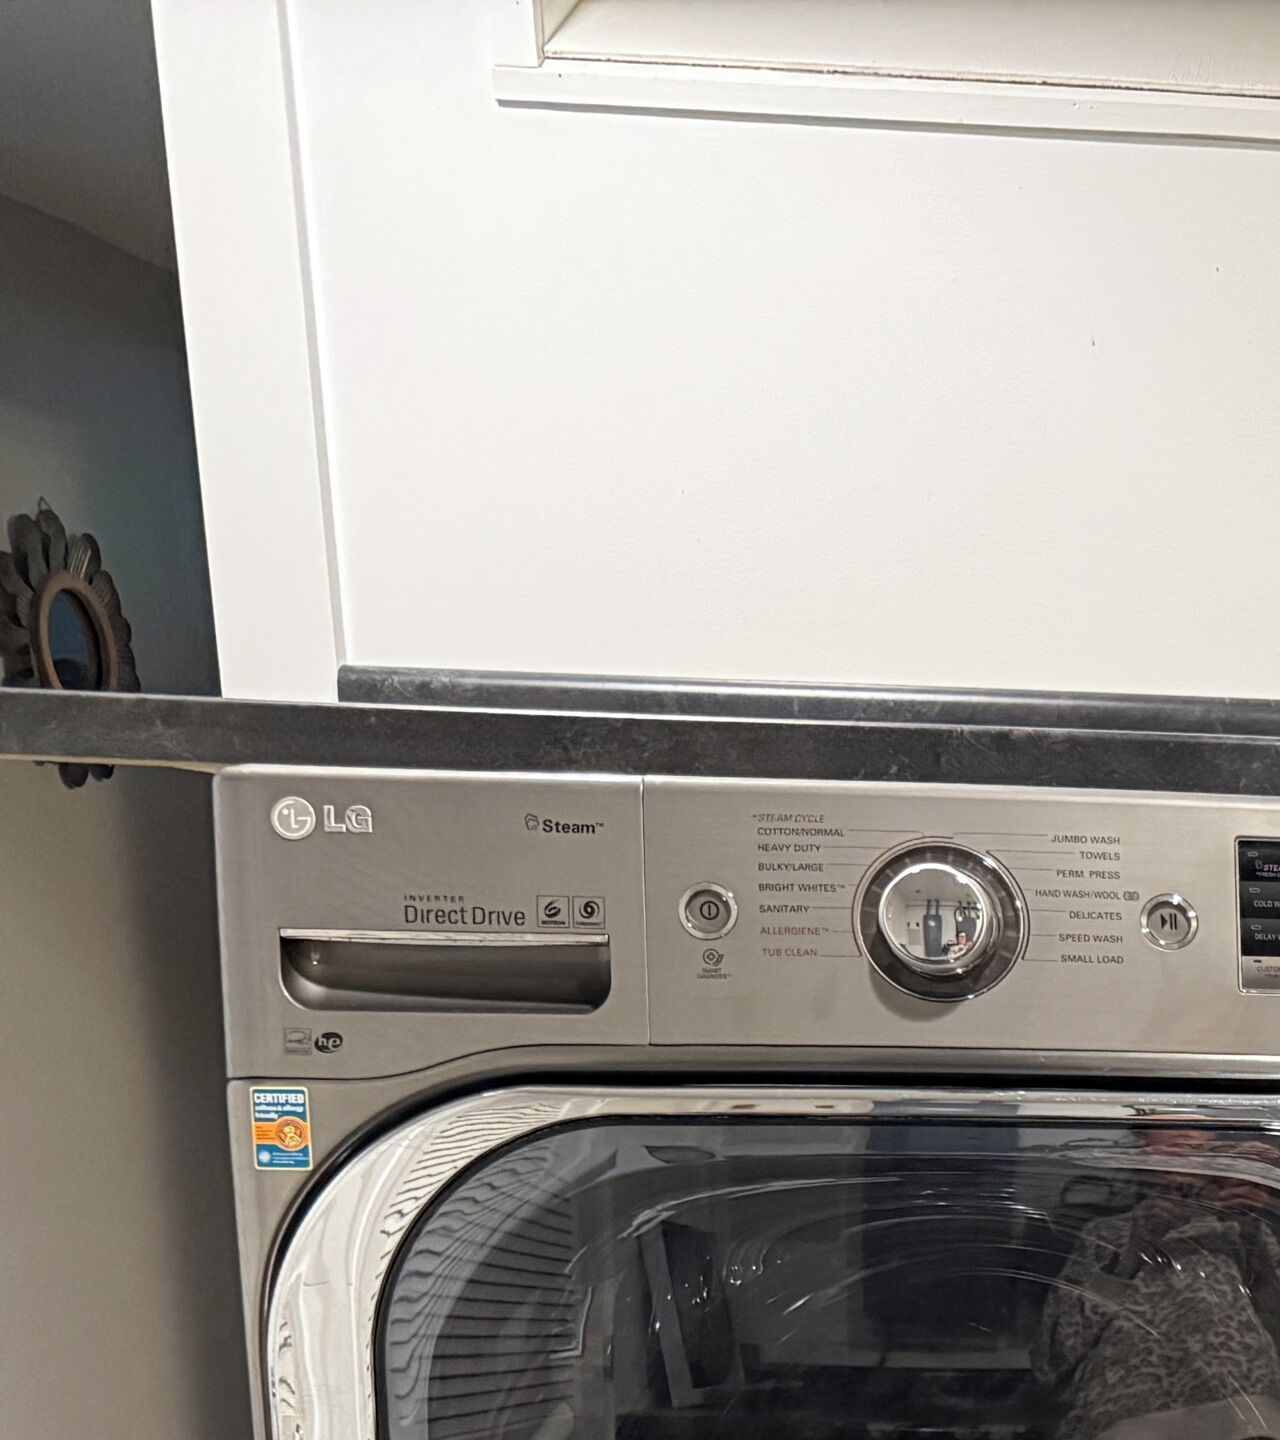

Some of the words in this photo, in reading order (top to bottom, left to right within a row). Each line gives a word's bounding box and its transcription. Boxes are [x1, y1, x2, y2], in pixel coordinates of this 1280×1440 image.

[323, 804, 373, 834] LG
[1051, 835, 1088, 844] JUMBO
[1090, 836, 1121, 845] WASH
[758, 843, 790, 852] HEAVY
[794, 844, 821, 852] DUTY
[1080, 851, 1121, 861] TOWELS
[758, 862, 824, 872] BULKY/LARGE
[1089, 870, 1121, 880] PRESS
[758, 883, 794, 892] BRIGHT
[404, 895, 465, 903] INVERTER
[1035, 889, 1061, 898] HAND
[1063, 890, 1121, 900] WASH/WOOL
[759, 904, 810, 913] SANITARY
[404, 904, 467, 925] Direct
[472, 906, 526, 927] Drive
[1069, 911, 1122, 921] DELICATES
[1059, 934, 1091, 943] SPEED
[1093, 934, 1123, 944] WASH
[1254, 933, 1275, 941] DELAY
[762, 948, 782, 957] TUB
[784, 948, 818, 957] CLEAN
[1061, 954, 1094, 964] SMALL
[1096, 955, 1124, 965] LOAD
[254, 1093, 305, 1104] CERTIFIED
